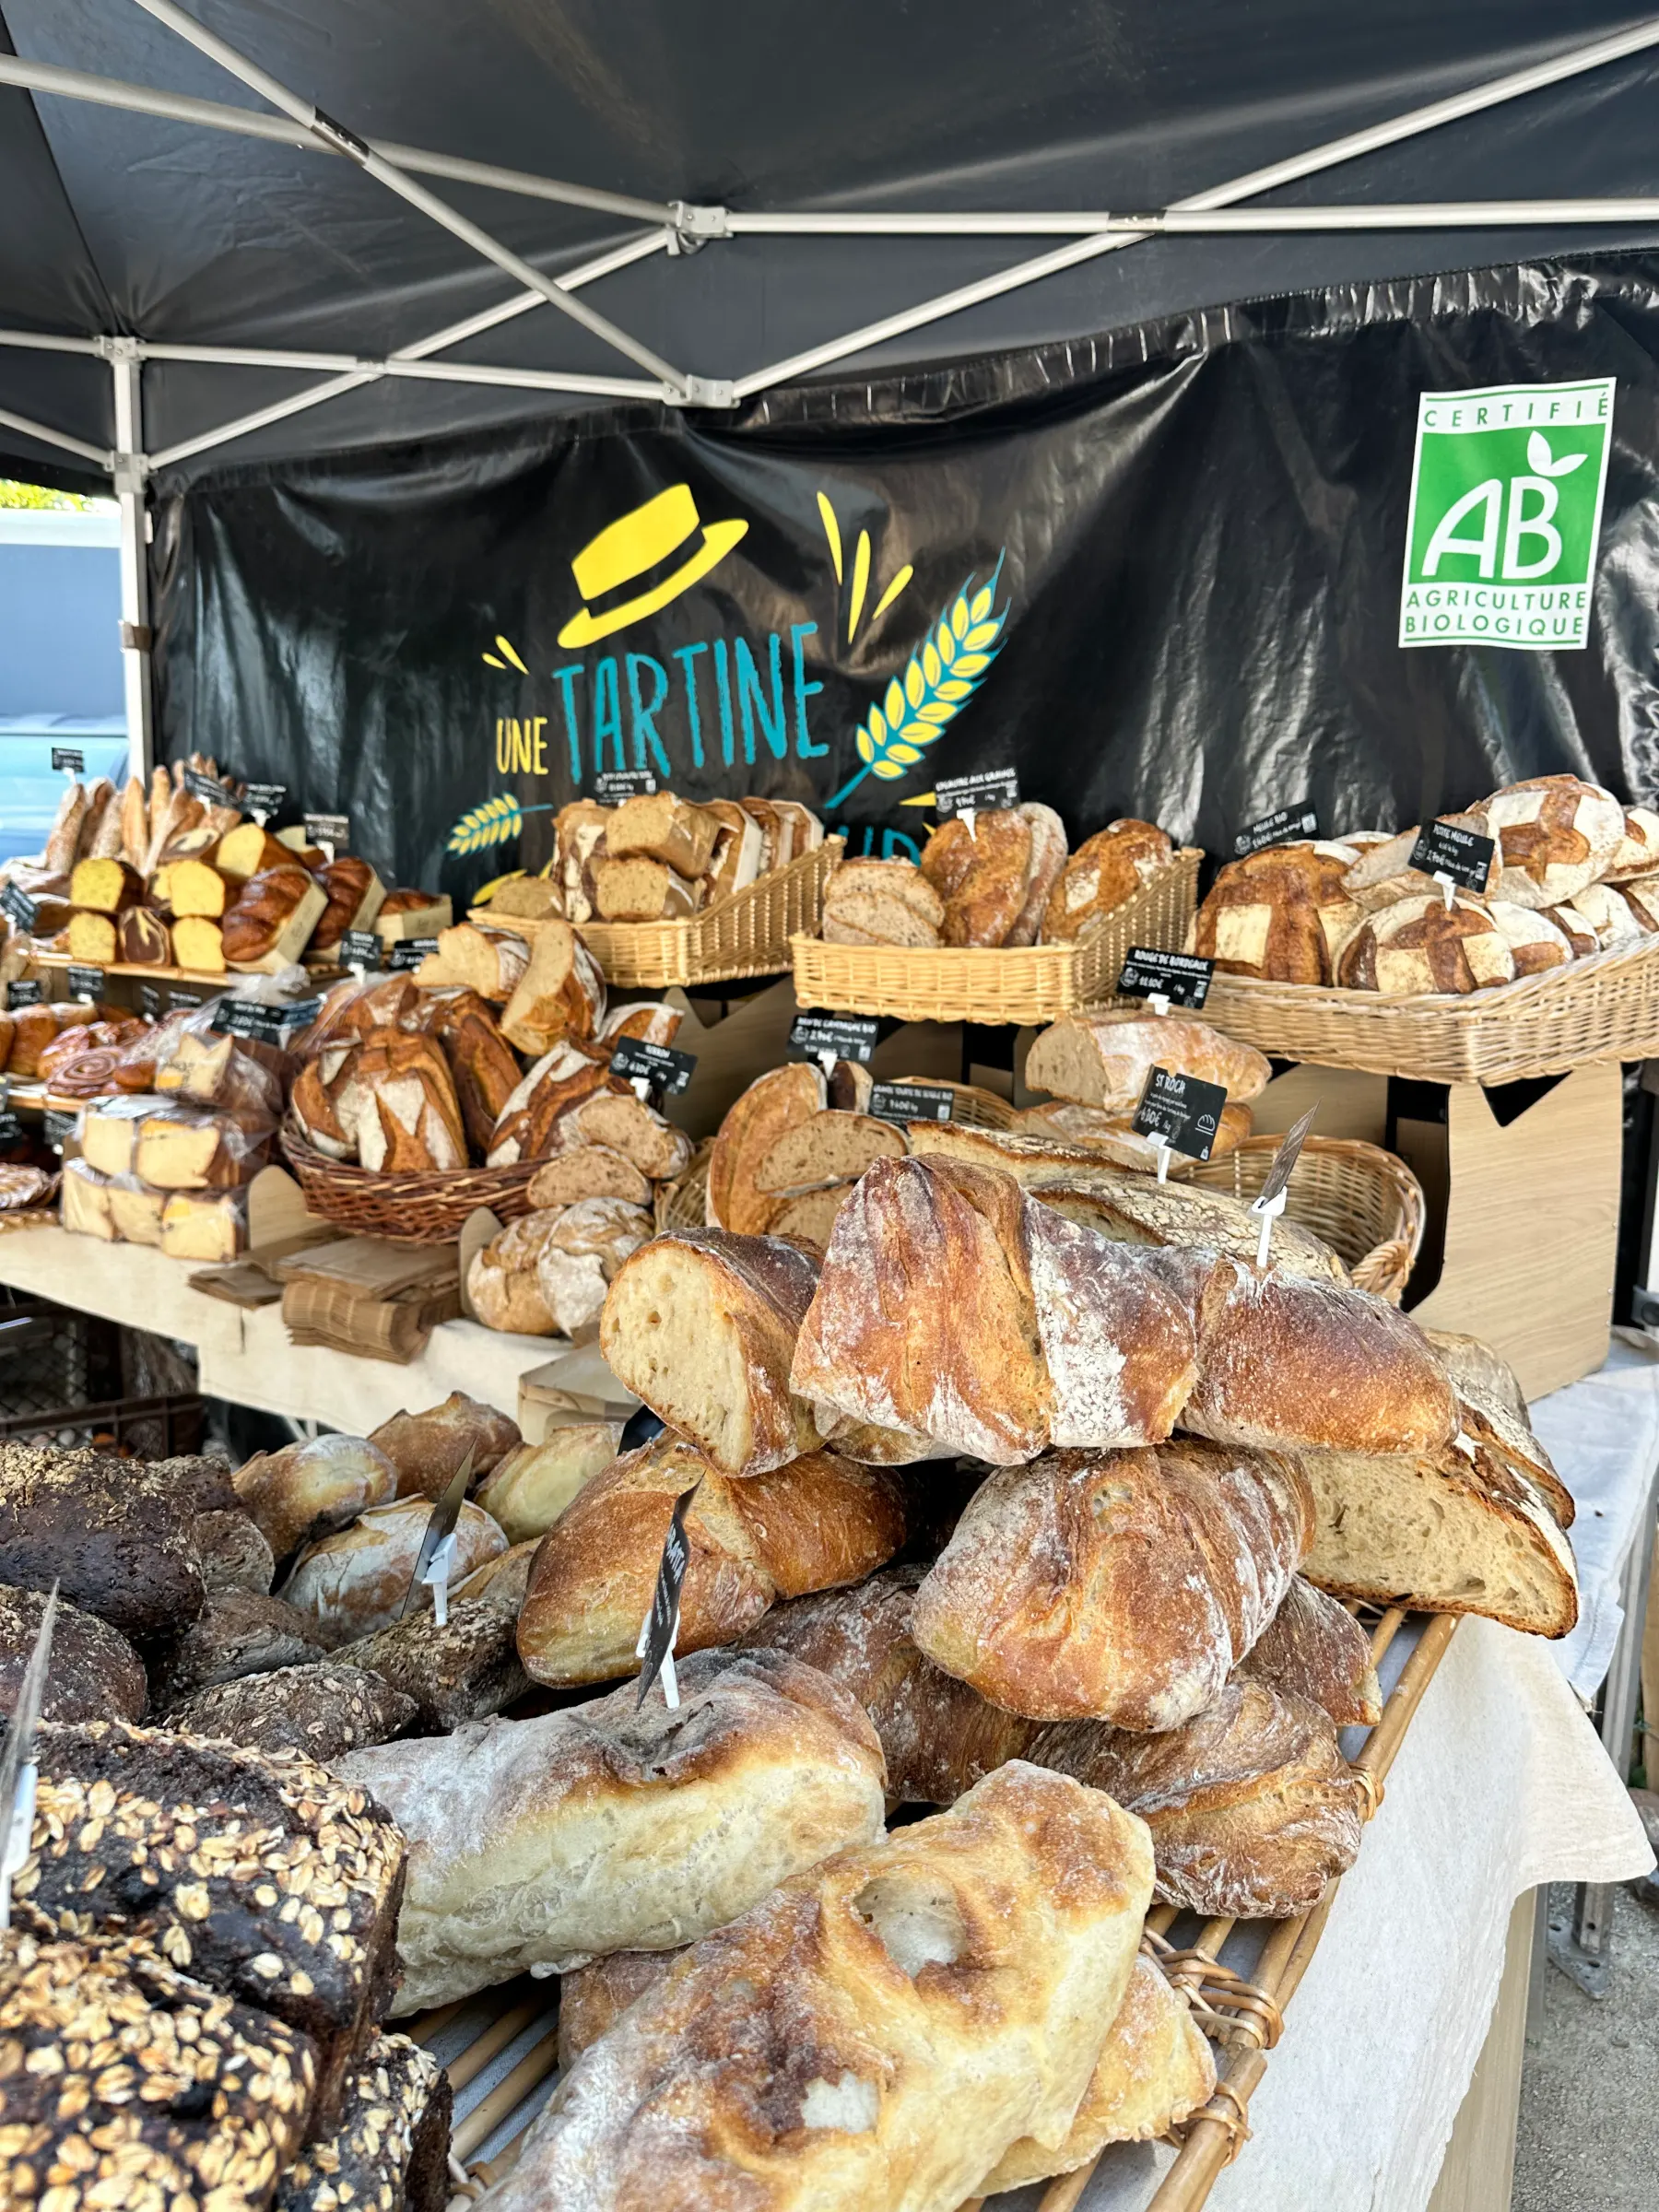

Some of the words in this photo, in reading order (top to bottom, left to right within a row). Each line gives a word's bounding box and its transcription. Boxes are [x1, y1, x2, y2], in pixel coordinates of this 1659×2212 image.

[1423, 393, 1609, 428] CERTIFIÉ
[1421, 475, 1562, 580] AB
[1406, 589, 1587, 611] AGRICULTURE
[1405, 614, 1583, 636] BIOLOGIQUE
[495, 716, 548, 775] UNE
[552, 621, 830, 785] TARTINE
[1274, 811, 1288, 825] BIO
[1155, 1073, 1166, 1088] ST
[1164, 1077, 1186, 1094] ROCH
